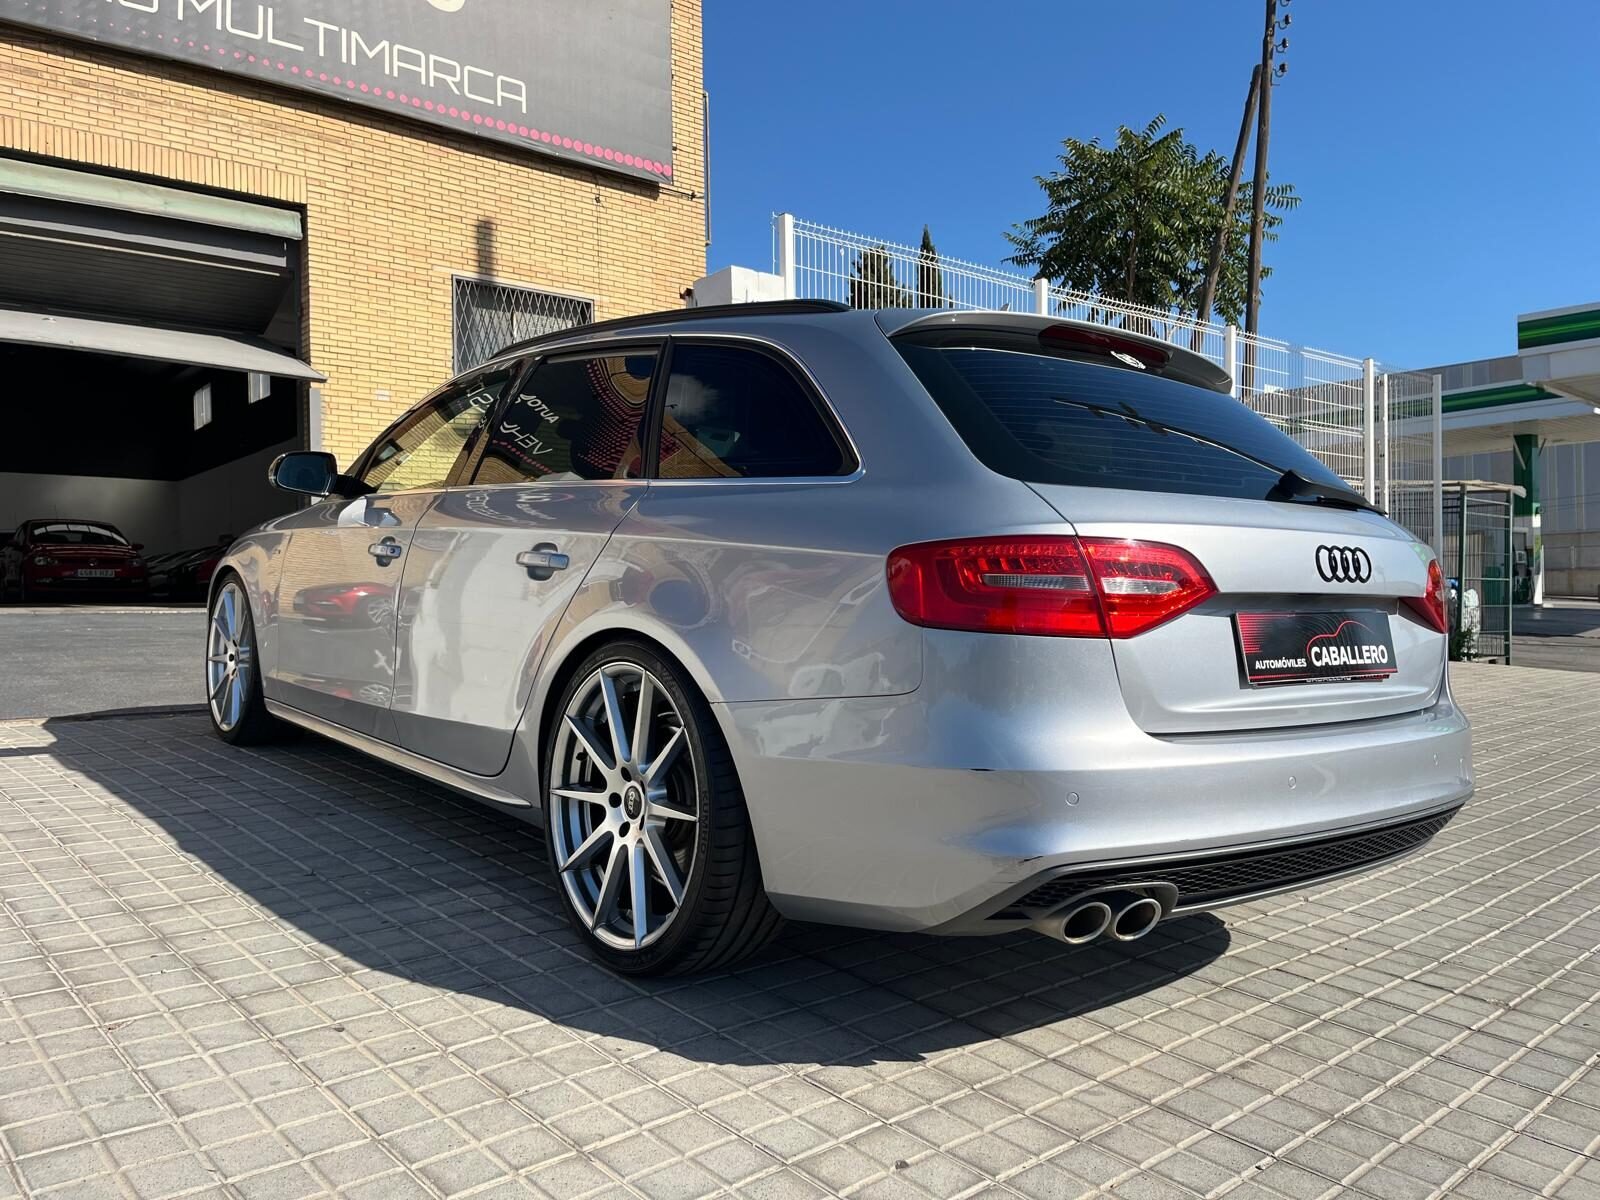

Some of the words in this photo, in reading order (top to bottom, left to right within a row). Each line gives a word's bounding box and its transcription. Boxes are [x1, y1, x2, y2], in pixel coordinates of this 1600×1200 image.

[178, 0, 527, 114] MULTIMARCA
[1255, 656, 1307, 670] AUTOMÓVILES
[1310, 644, 1389, 667] CABALLERO
[700, 790, 709, 854] KUMHO
